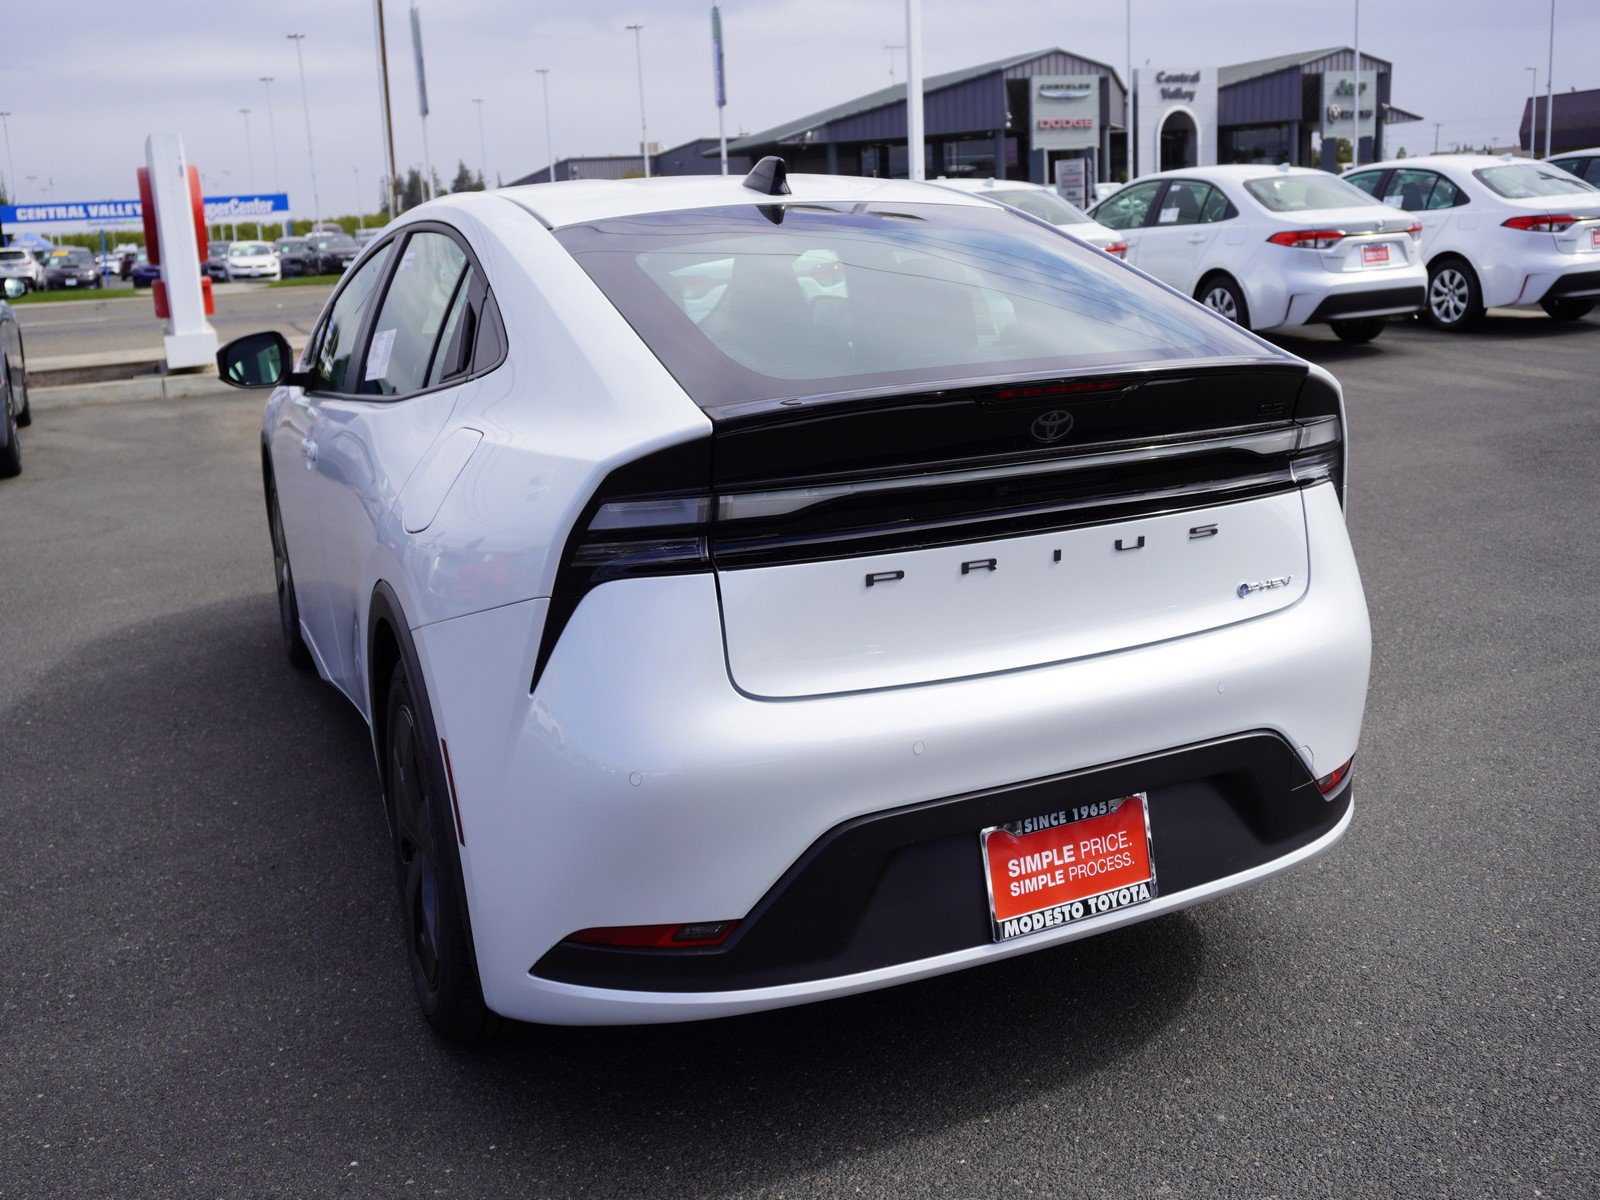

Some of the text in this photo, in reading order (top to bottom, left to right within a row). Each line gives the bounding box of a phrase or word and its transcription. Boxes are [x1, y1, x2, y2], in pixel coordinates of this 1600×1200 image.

[1156, 70, 1201, 84] Central
[1038, 118, 1094, 130] DODGE
[16, 206, 87, 221] CENTRAL
[865, 523, 1218, 587] PRIUS
[1024, 801, 1108, 833] SINCE 1965
[1008, 831, 1132, 877] SIMPLE PRICE.
[1010, 852, 1135, 897] SIMPLE PROCESS.
[1004, 883, 1151, 938] MODESTO TOYOTA
